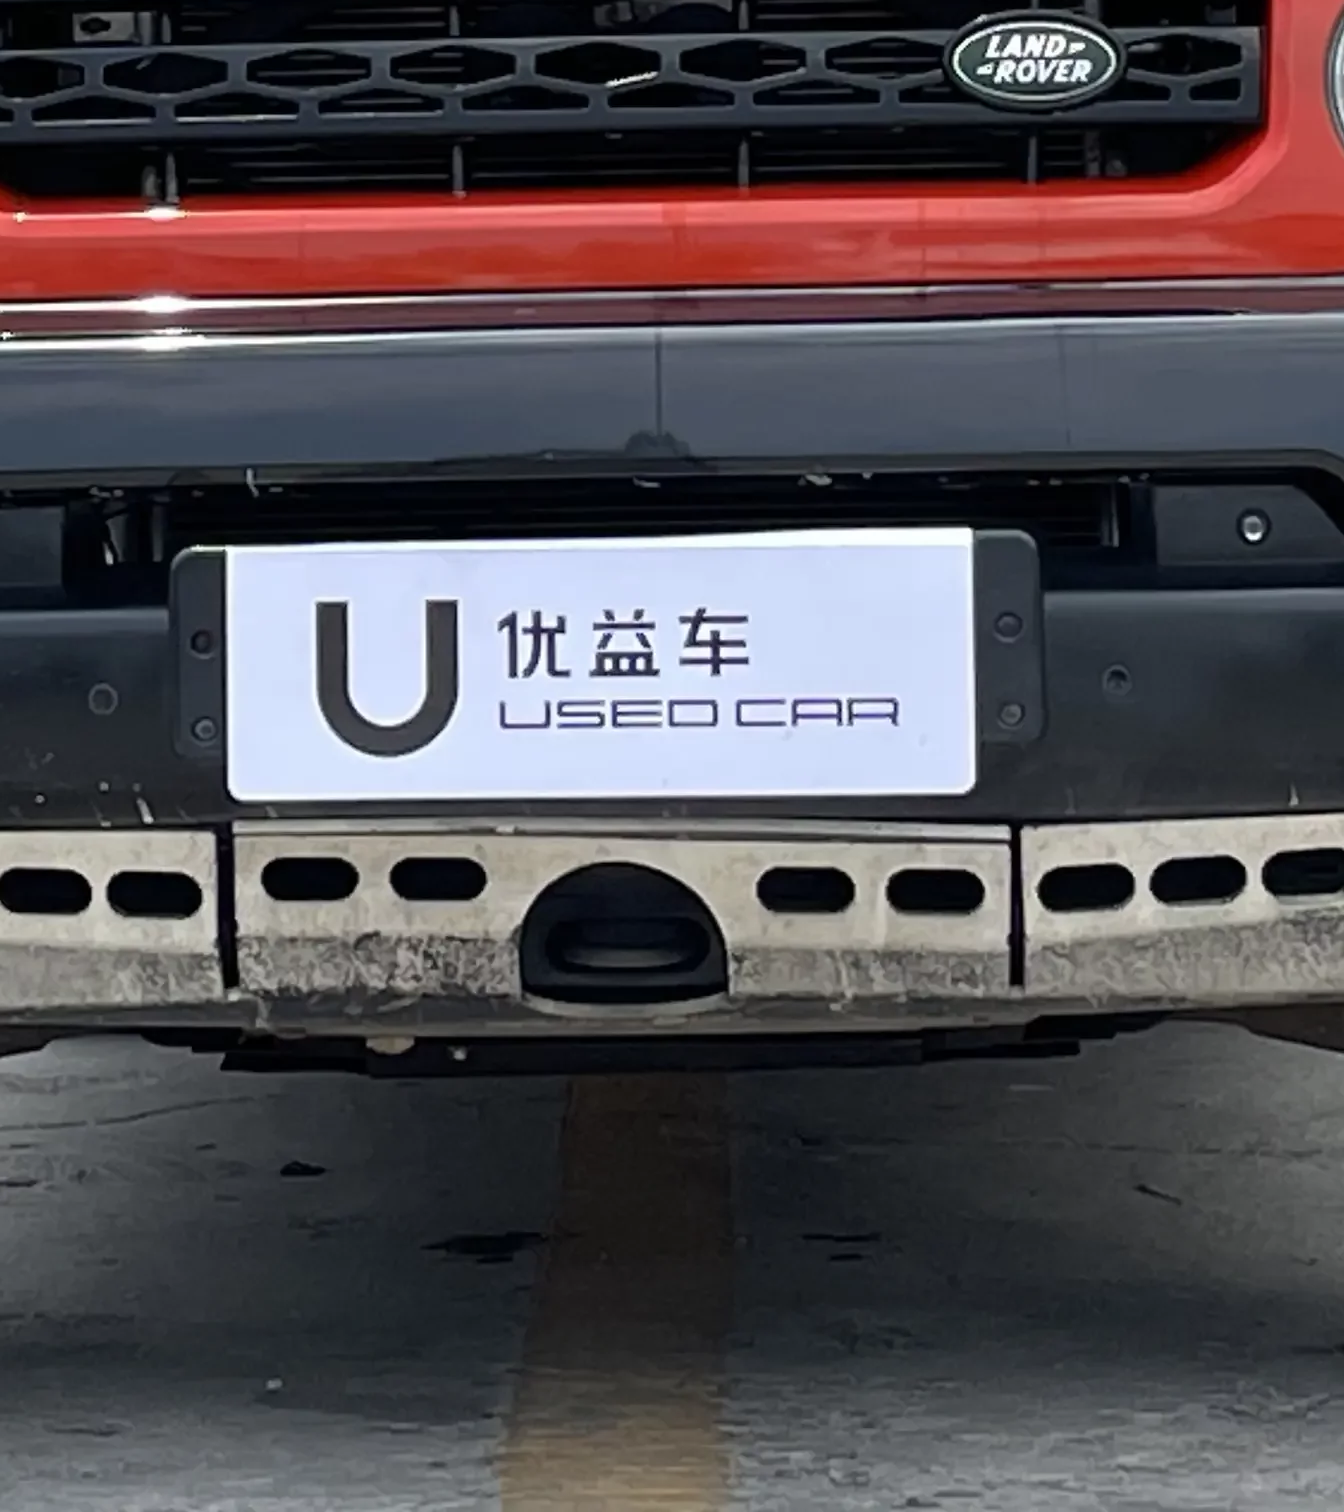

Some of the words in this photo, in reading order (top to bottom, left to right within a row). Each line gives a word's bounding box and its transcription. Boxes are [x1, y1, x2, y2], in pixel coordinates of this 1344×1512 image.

[497, 607, 750, 679] 优益车
[499, 699, 719, 730] USED
[735, 697, 900, 728] CAR
